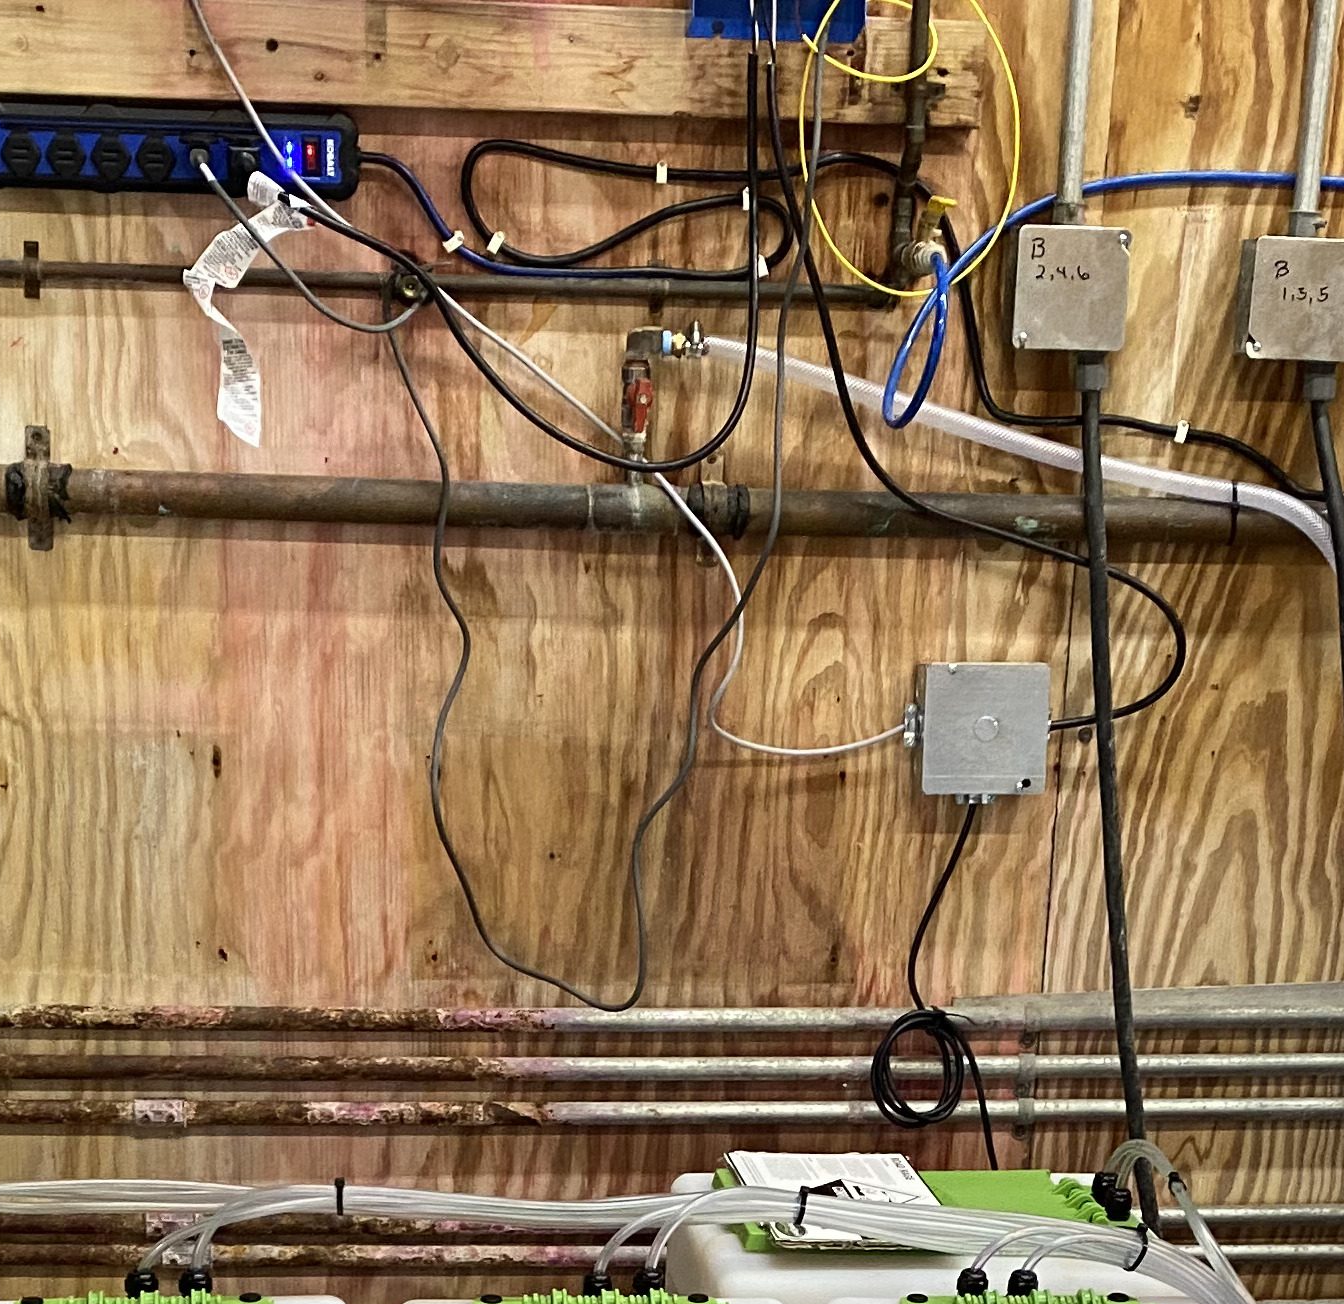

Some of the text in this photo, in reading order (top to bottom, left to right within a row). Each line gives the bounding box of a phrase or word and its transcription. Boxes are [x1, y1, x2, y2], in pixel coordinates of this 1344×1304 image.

[1031, 237, 1047, 259] B
[1034, 264, 1091, 282] 2,4,6
[1274, 260, 1289, 278] B
[1281, 285, 1330, 304] 1,3,5
